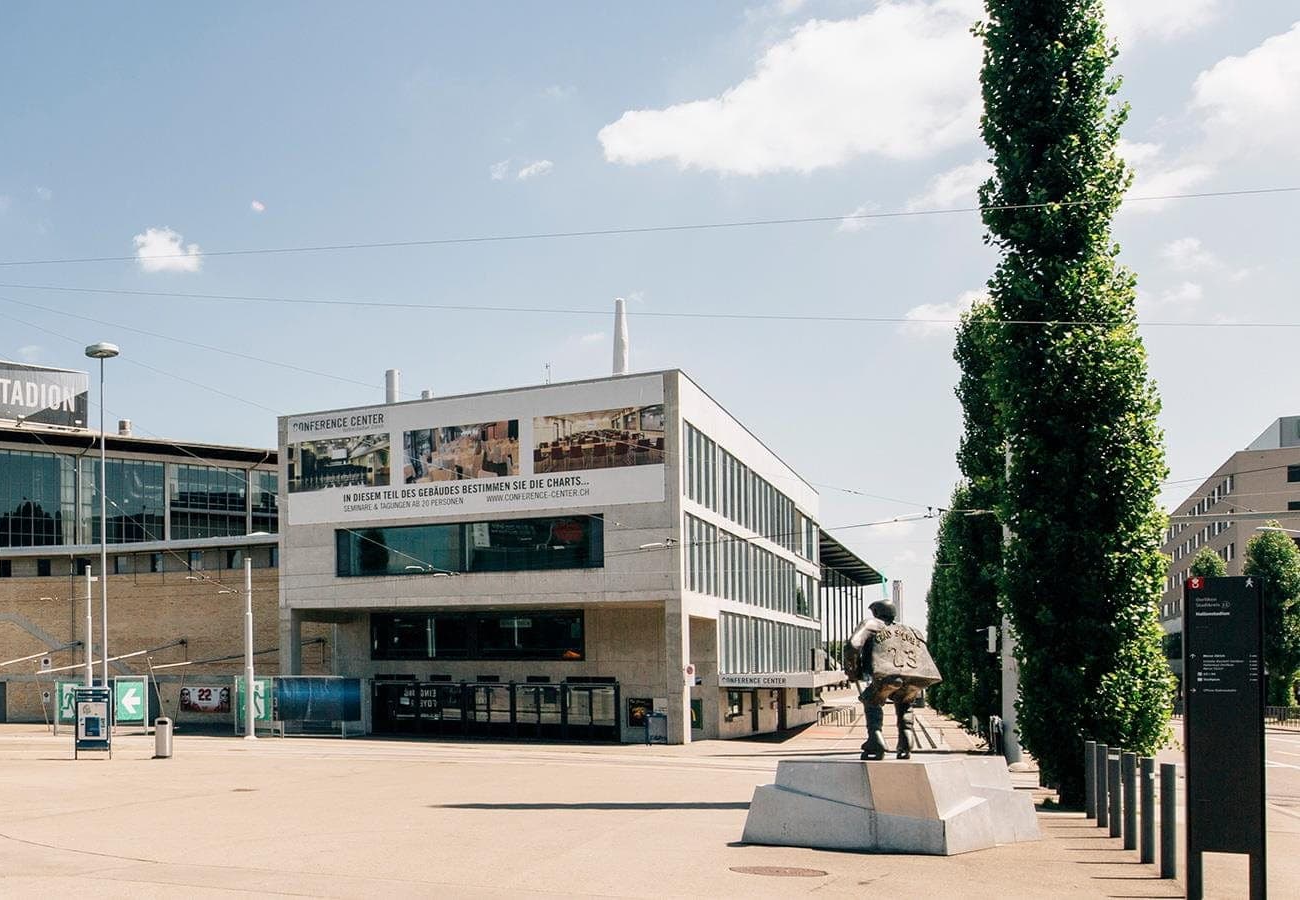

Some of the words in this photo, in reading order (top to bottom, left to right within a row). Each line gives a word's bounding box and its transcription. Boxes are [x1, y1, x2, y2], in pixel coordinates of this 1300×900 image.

[293, 417, 348, 432] CONFERENCE
[350, 413, 384, 427] CENTER
[343, 494, 351, 502] IN
[353, 491, 380, 502] DIESEM
[383, 490, 399, 500] TEIL
[401, 489, 416, 498] DES
[418, 484, 460, 497] GEBÄUDES
[462, 482, 510, 494] BESTIMMEN
[513, 480, 527, 490] SIE
[529, 479, 544, 489] DIE
[486, 488, 590, 502] WWW.CONFERENCE-CENTER.CH
[343, 503, 372, 513] SEMINARE
[380, 500, 411, 511] TAGUNGEN
[431, 497, 464, 507] PERSONEN
[198, 688, 212, 701] 22
